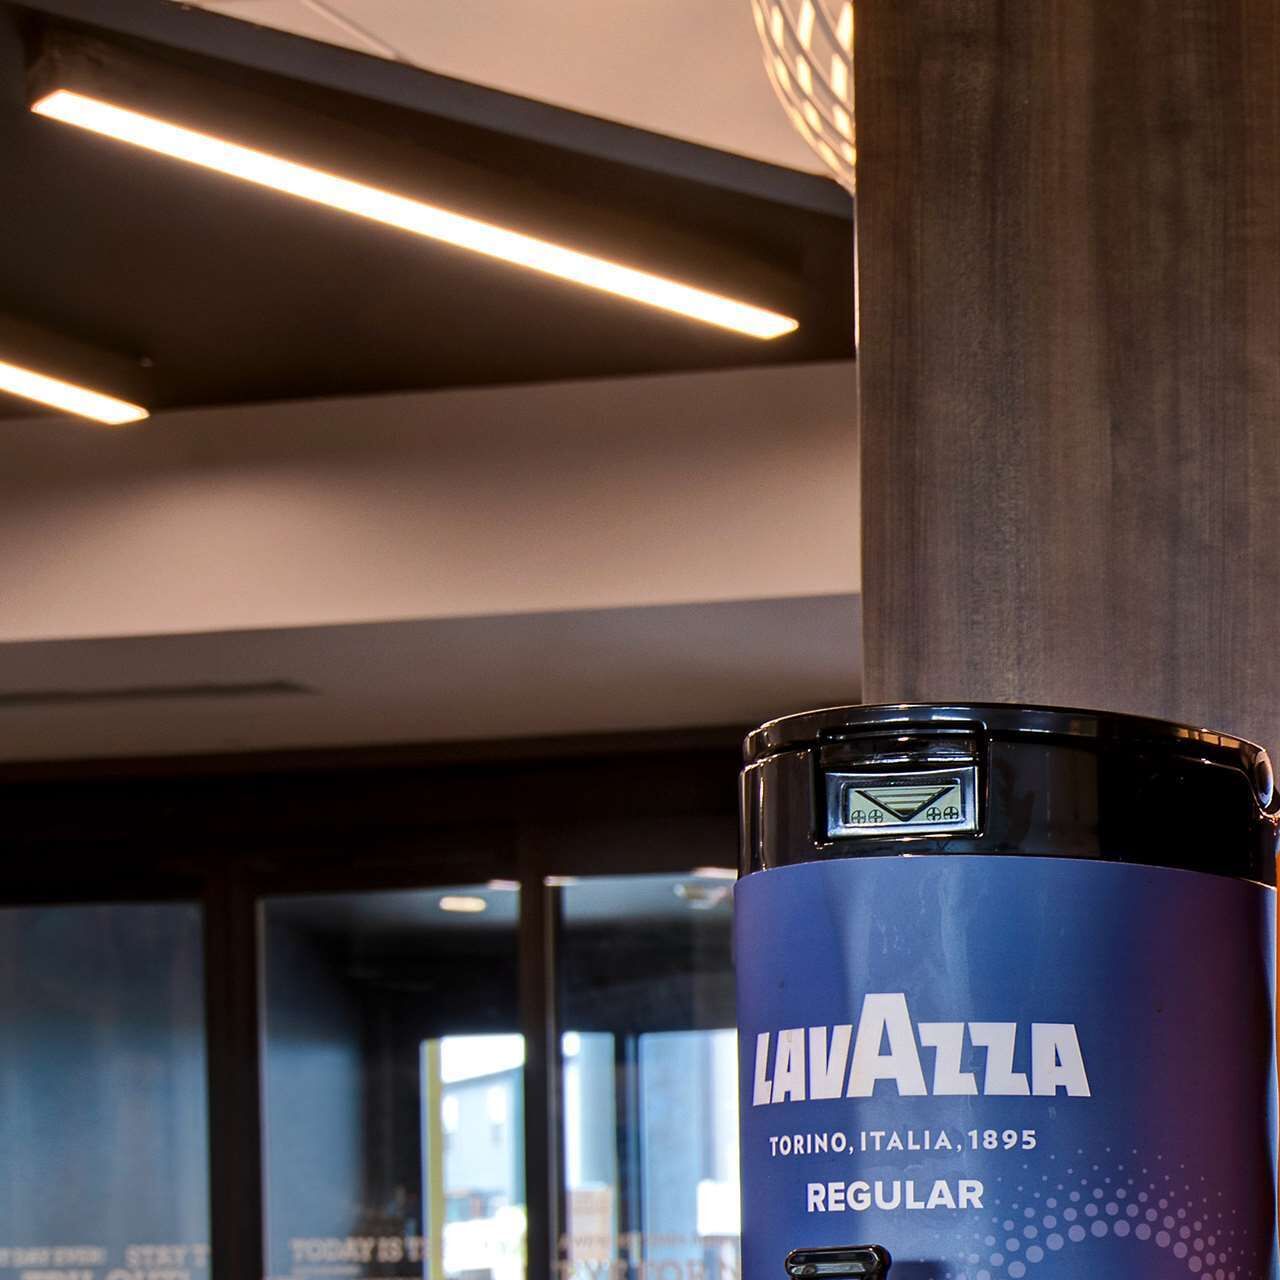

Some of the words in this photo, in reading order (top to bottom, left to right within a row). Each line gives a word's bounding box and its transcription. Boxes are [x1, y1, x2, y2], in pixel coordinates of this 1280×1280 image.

[753, 993, 1091, 1106] LAVAZZA
[769, 1132, 854, 1157] TORINO,
[860, 1130, 962, 1153] ITALIA,
[967, 1129, 1037, 1151] 1895
[807, 1180, 984, 1212] REGULAR
[291, 1238, 374, 1263] TODAY
